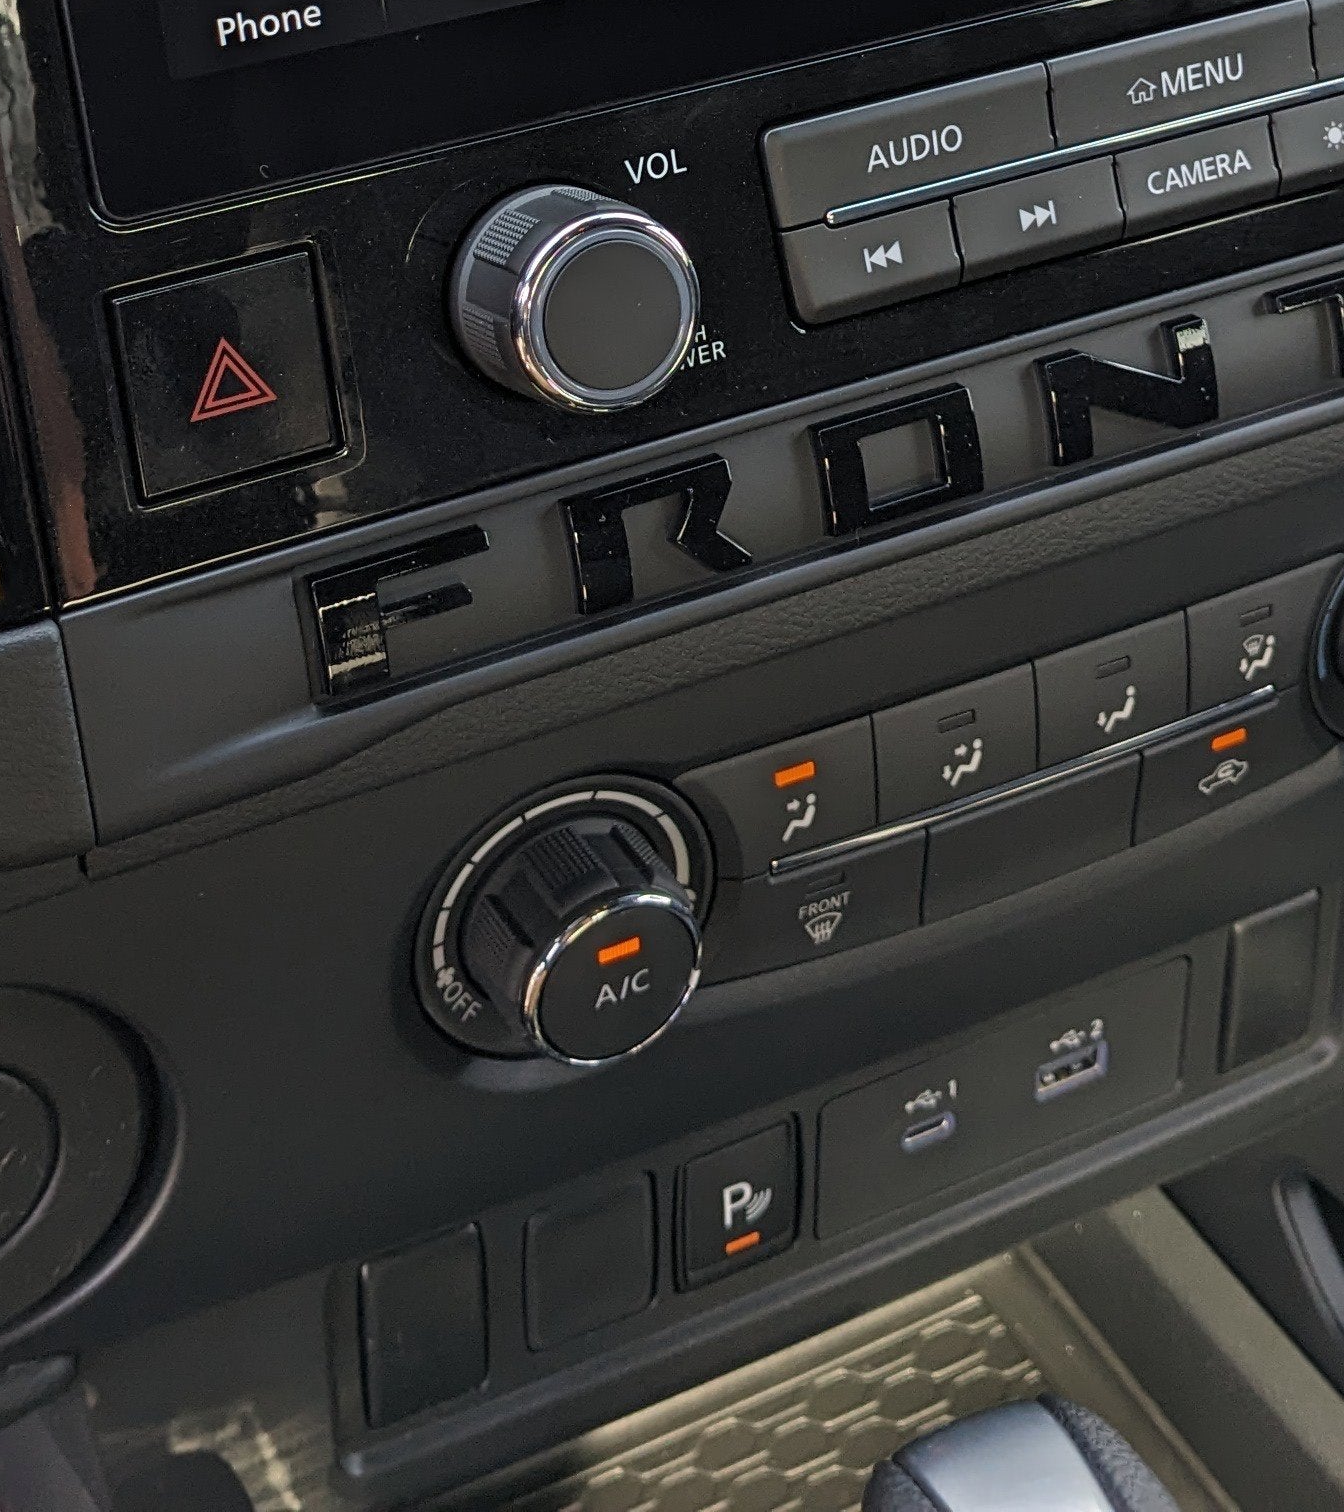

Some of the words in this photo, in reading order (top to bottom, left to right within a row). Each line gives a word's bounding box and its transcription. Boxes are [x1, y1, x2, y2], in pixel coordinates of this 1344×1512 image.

[215, 3, 323, 47] Phone
[1159, 53, 1245, 99] MENU
[623, 148, 688, 186] VOL
[865, 123, 964, 174] AUDIO
[1145, 148, 1253, 197] CAMERA
[679, 339, 728, 372] WER
[798, 891, 851, 920] FRONT
[443, 981, 482, 1022] OFF
[593, 968, 652, 1011] A/C
